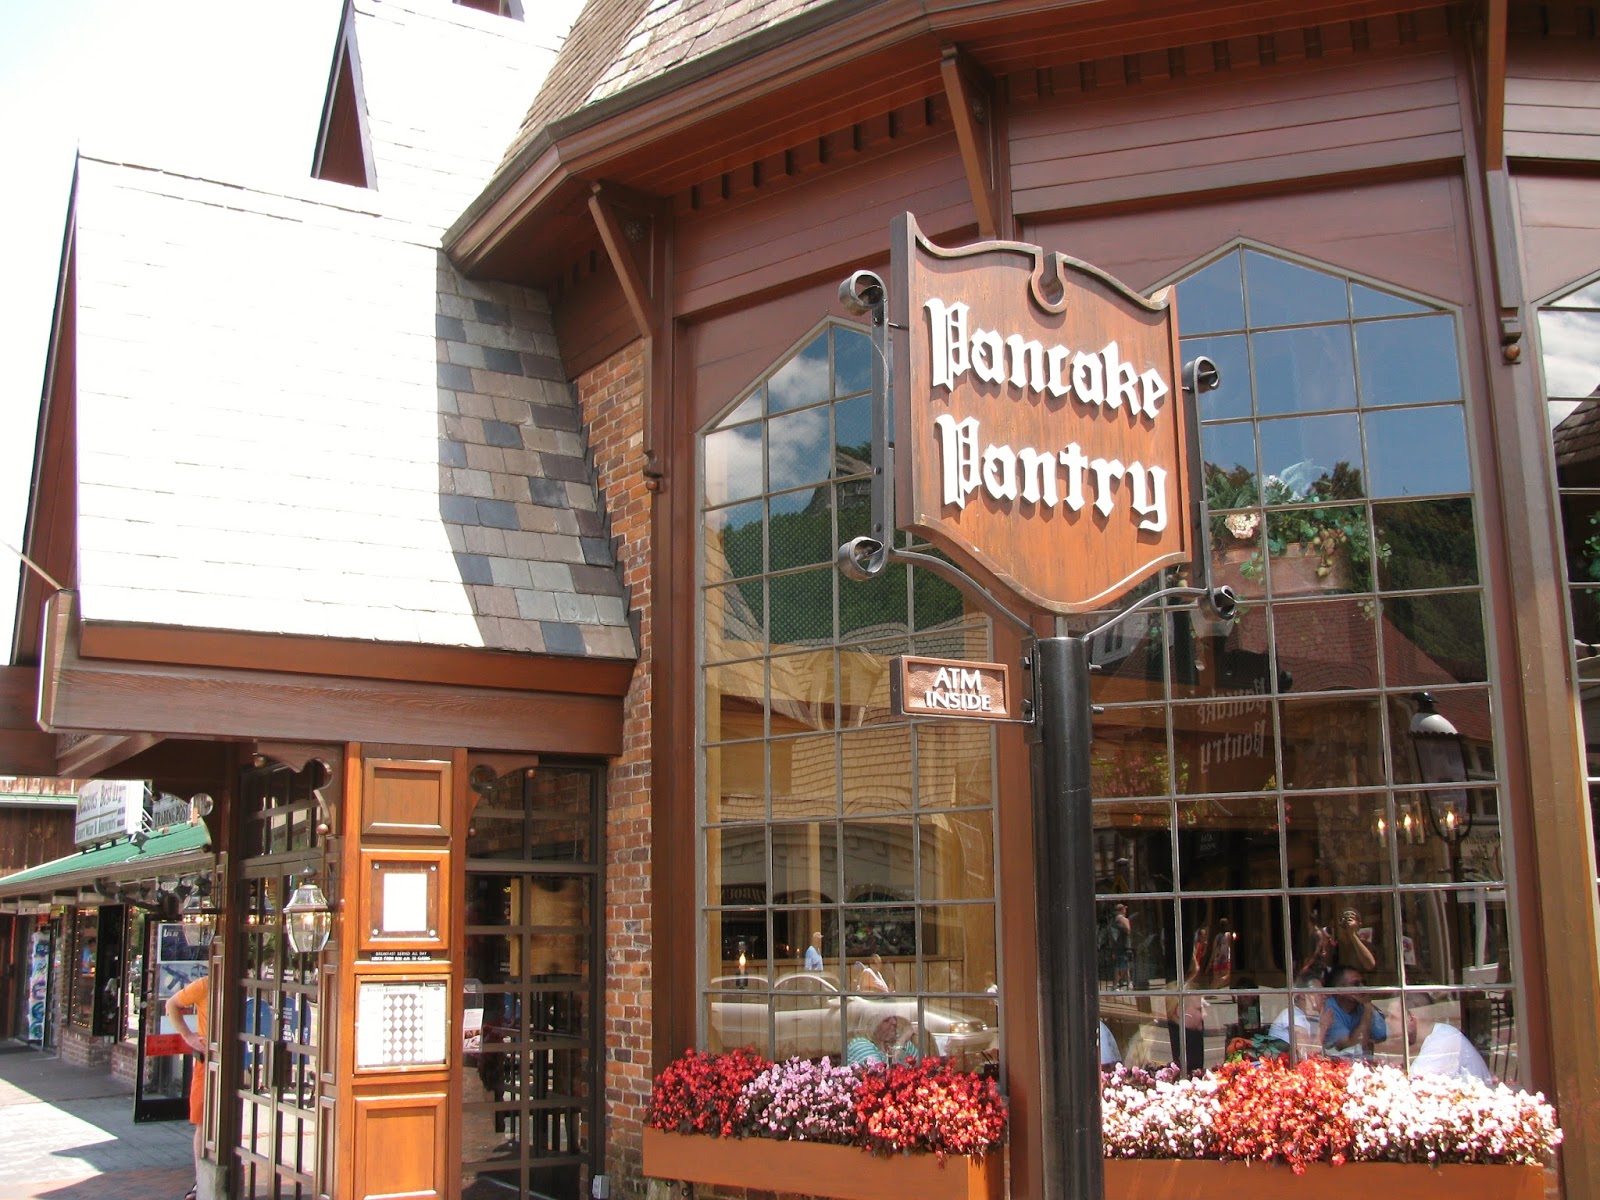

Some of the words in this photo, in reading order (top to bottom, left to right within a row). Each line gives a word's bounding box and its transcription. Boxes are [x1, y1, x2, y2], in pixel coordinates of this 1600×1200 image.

[923, 298, 1169, 419] Pancake
[934, 414, 1168, 533] Pantry
[925, 690, 992, 711] INSIDE
[933, 667, 982, 691] ATM
